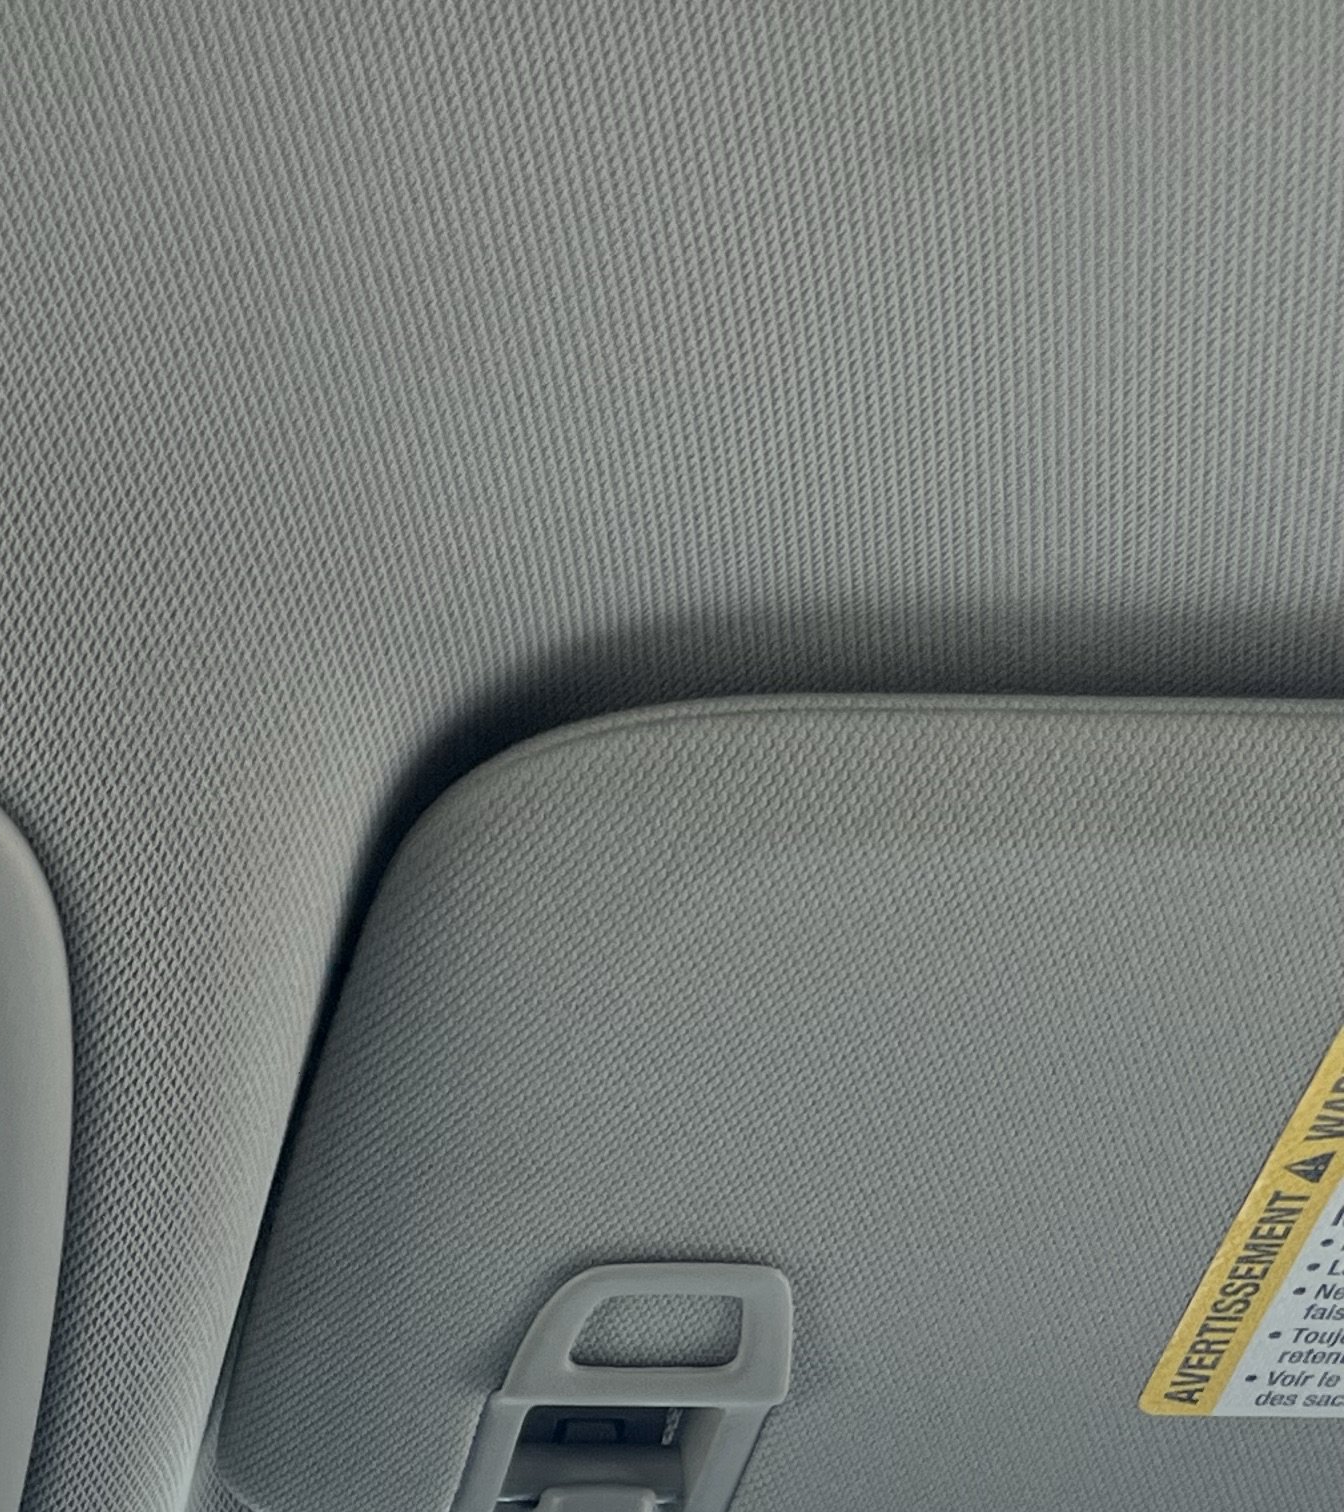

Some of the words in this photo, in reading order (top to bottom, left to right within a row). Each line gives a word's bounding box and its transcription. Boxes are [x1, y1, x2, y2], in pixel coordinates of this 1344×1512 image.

[1163, 1190, 1312, 1406] AVERTISSEMENT
[1267, 1371, 1315, 1388] Voir
[1318, 1371, 1341, 1388] le
[1255, 1391, 1298, 1408] des
